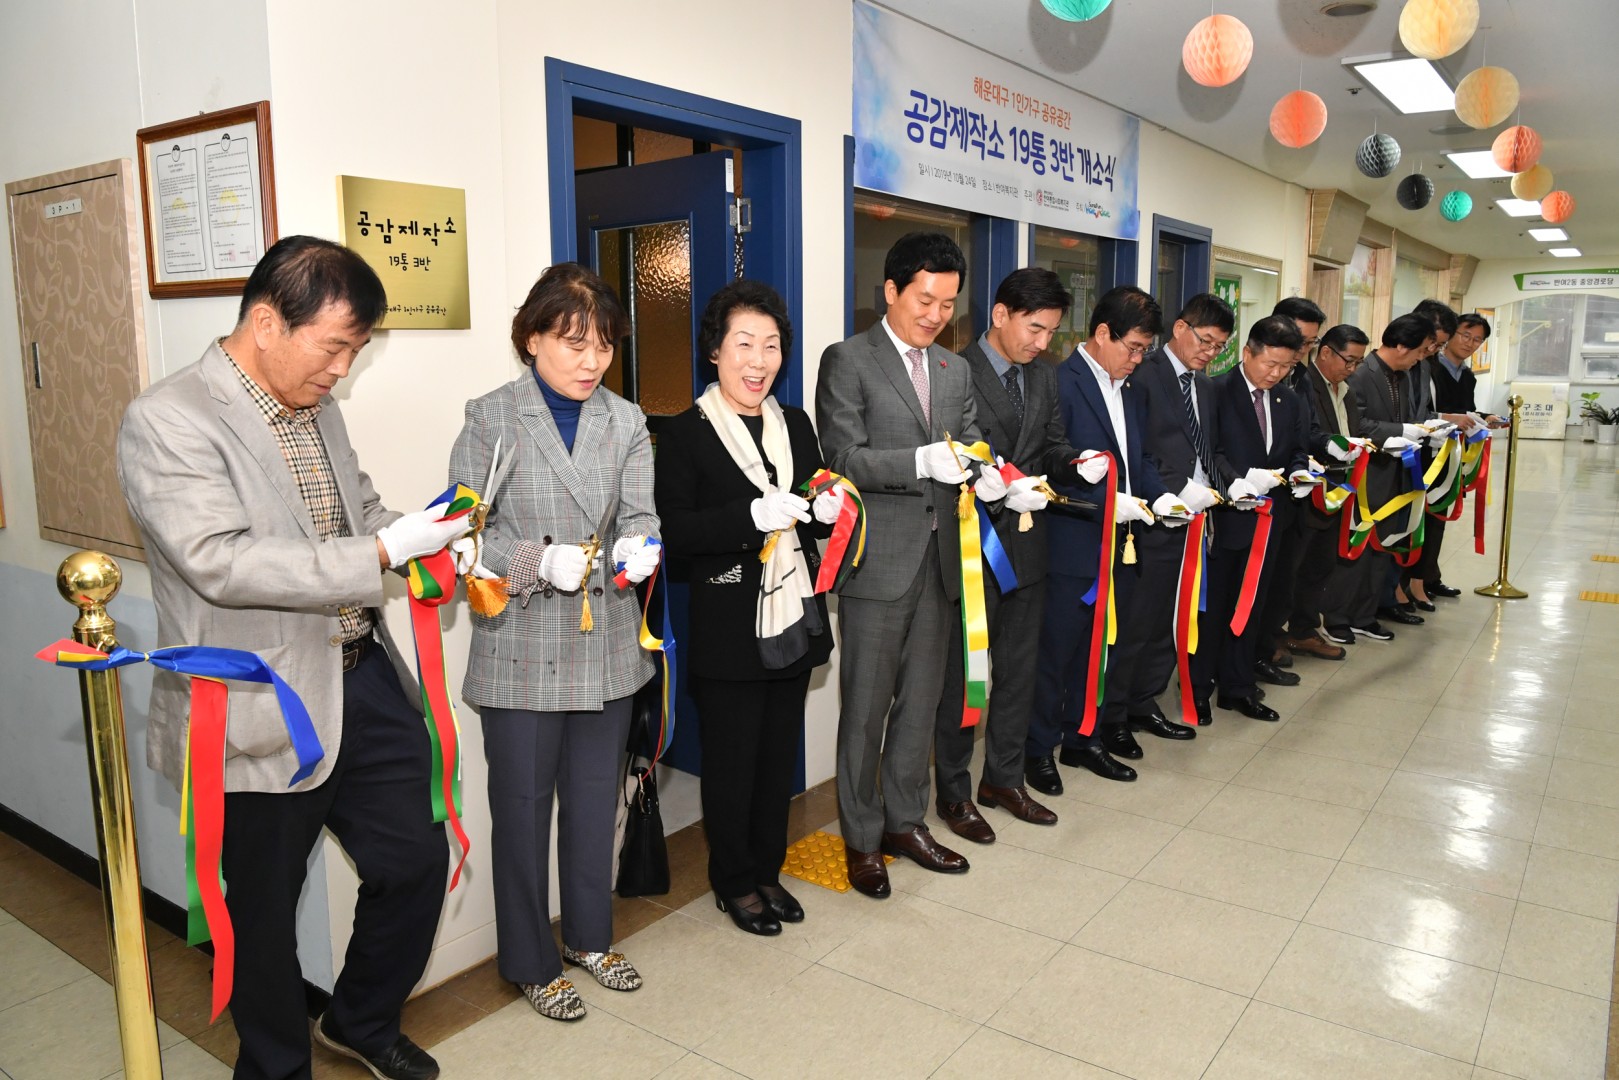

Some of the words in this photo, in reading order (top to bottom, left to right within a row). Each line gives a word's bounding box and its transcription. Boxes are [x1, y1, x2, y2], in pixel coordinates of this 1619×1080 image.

[973, 76, 1010, 108] 해운대구
[1011, 92, 1041, 118] 1인가구
[1041, 102, 1072, 130] 공유공간
[903, 89, 1005, 161] 공감제작소
[1009, 126, 1047, 176] 19통
[1050, 138, 1075, 183] 3반
[1077, 148, 1117, 192] 개소식
[357, 211, 457, 246] 공감제작소
[389, 253, 409, 271] 19통
[413, 257, 432, 271] 3반
[1580, 277, 1614, 286] 중앙경로당
[403, 304, 423, 316] 1인가구
[425, 304, 447, 316] 공유공간
